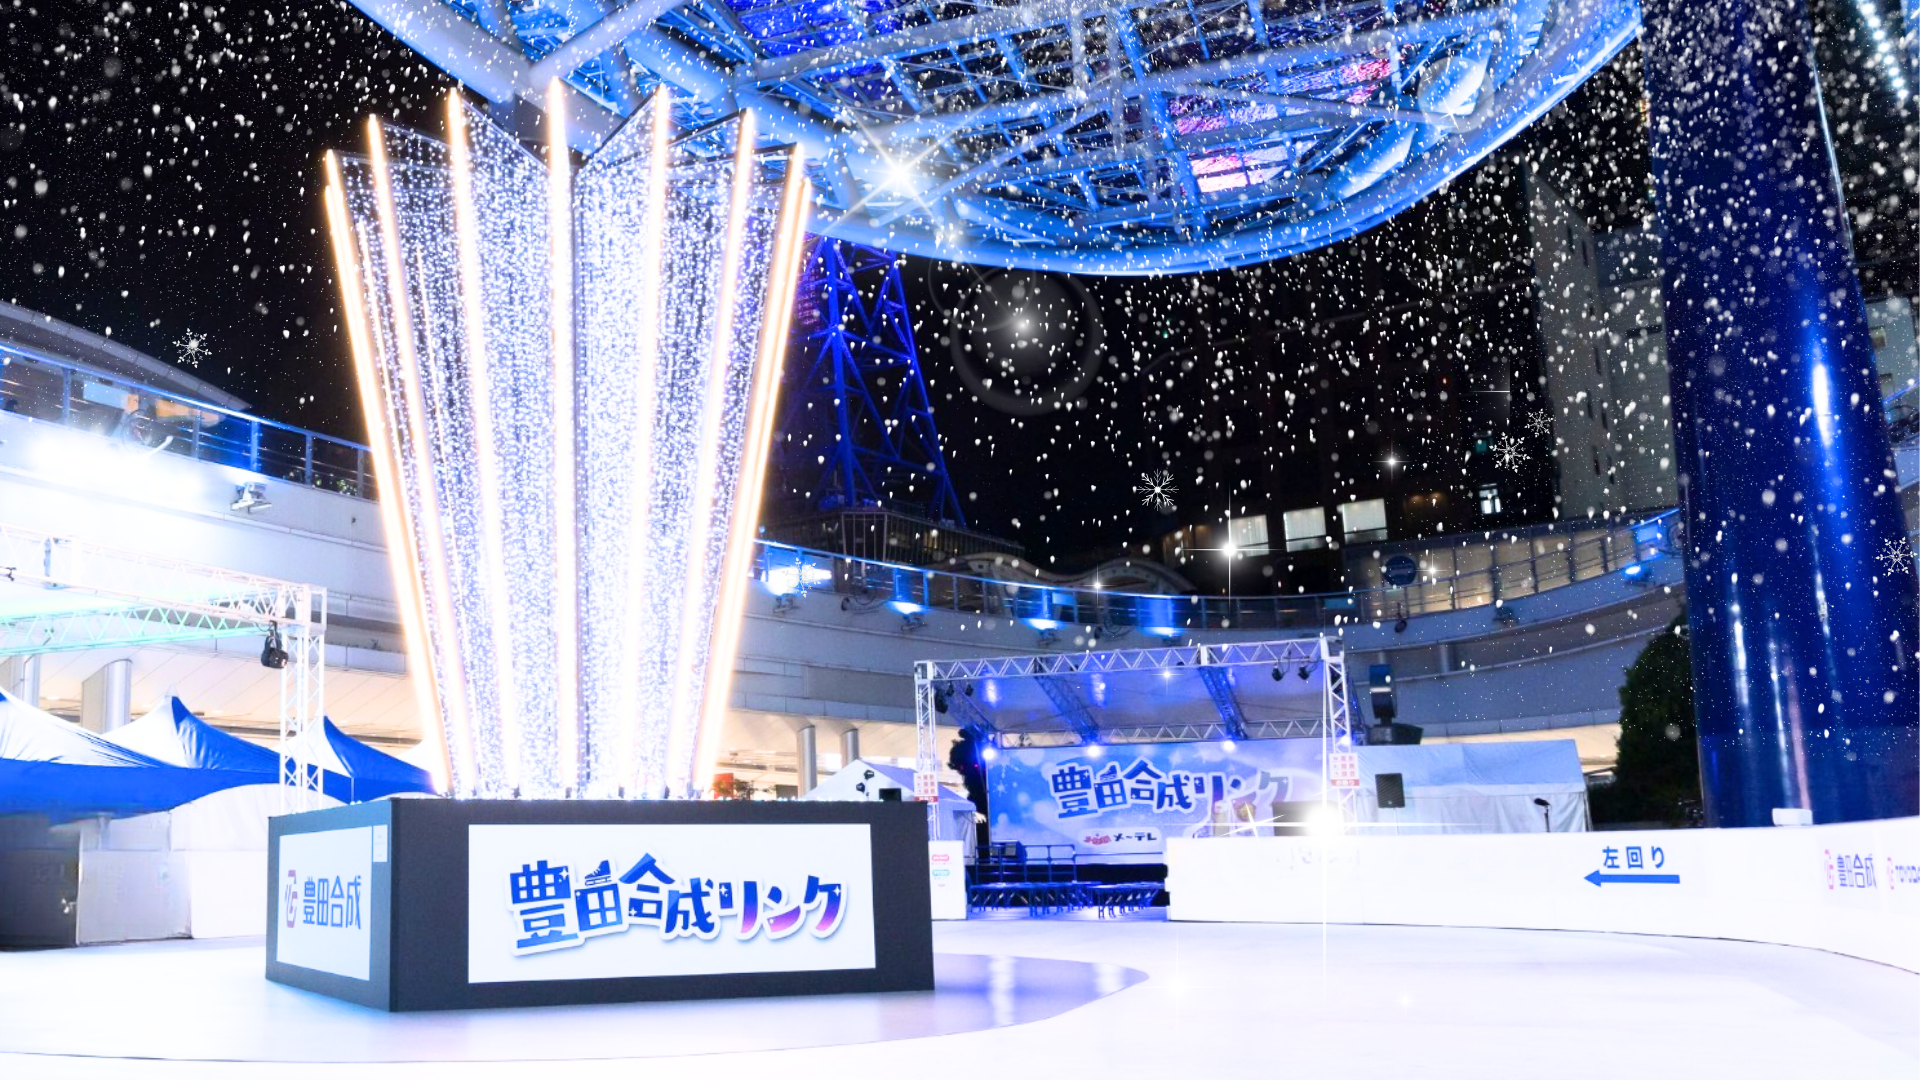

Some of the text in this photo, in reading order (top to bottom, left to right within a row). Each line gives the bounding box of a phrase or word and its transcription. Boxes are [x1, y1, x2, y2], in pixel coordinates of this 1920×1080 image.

[1602, 846, 1665, 869] 左回り
[1836, 853, 1878, 889] 豊田合成
[302, 875, 361, 930] 豊田合成
[509, 852, 843, 949] 豊田合成リンク
